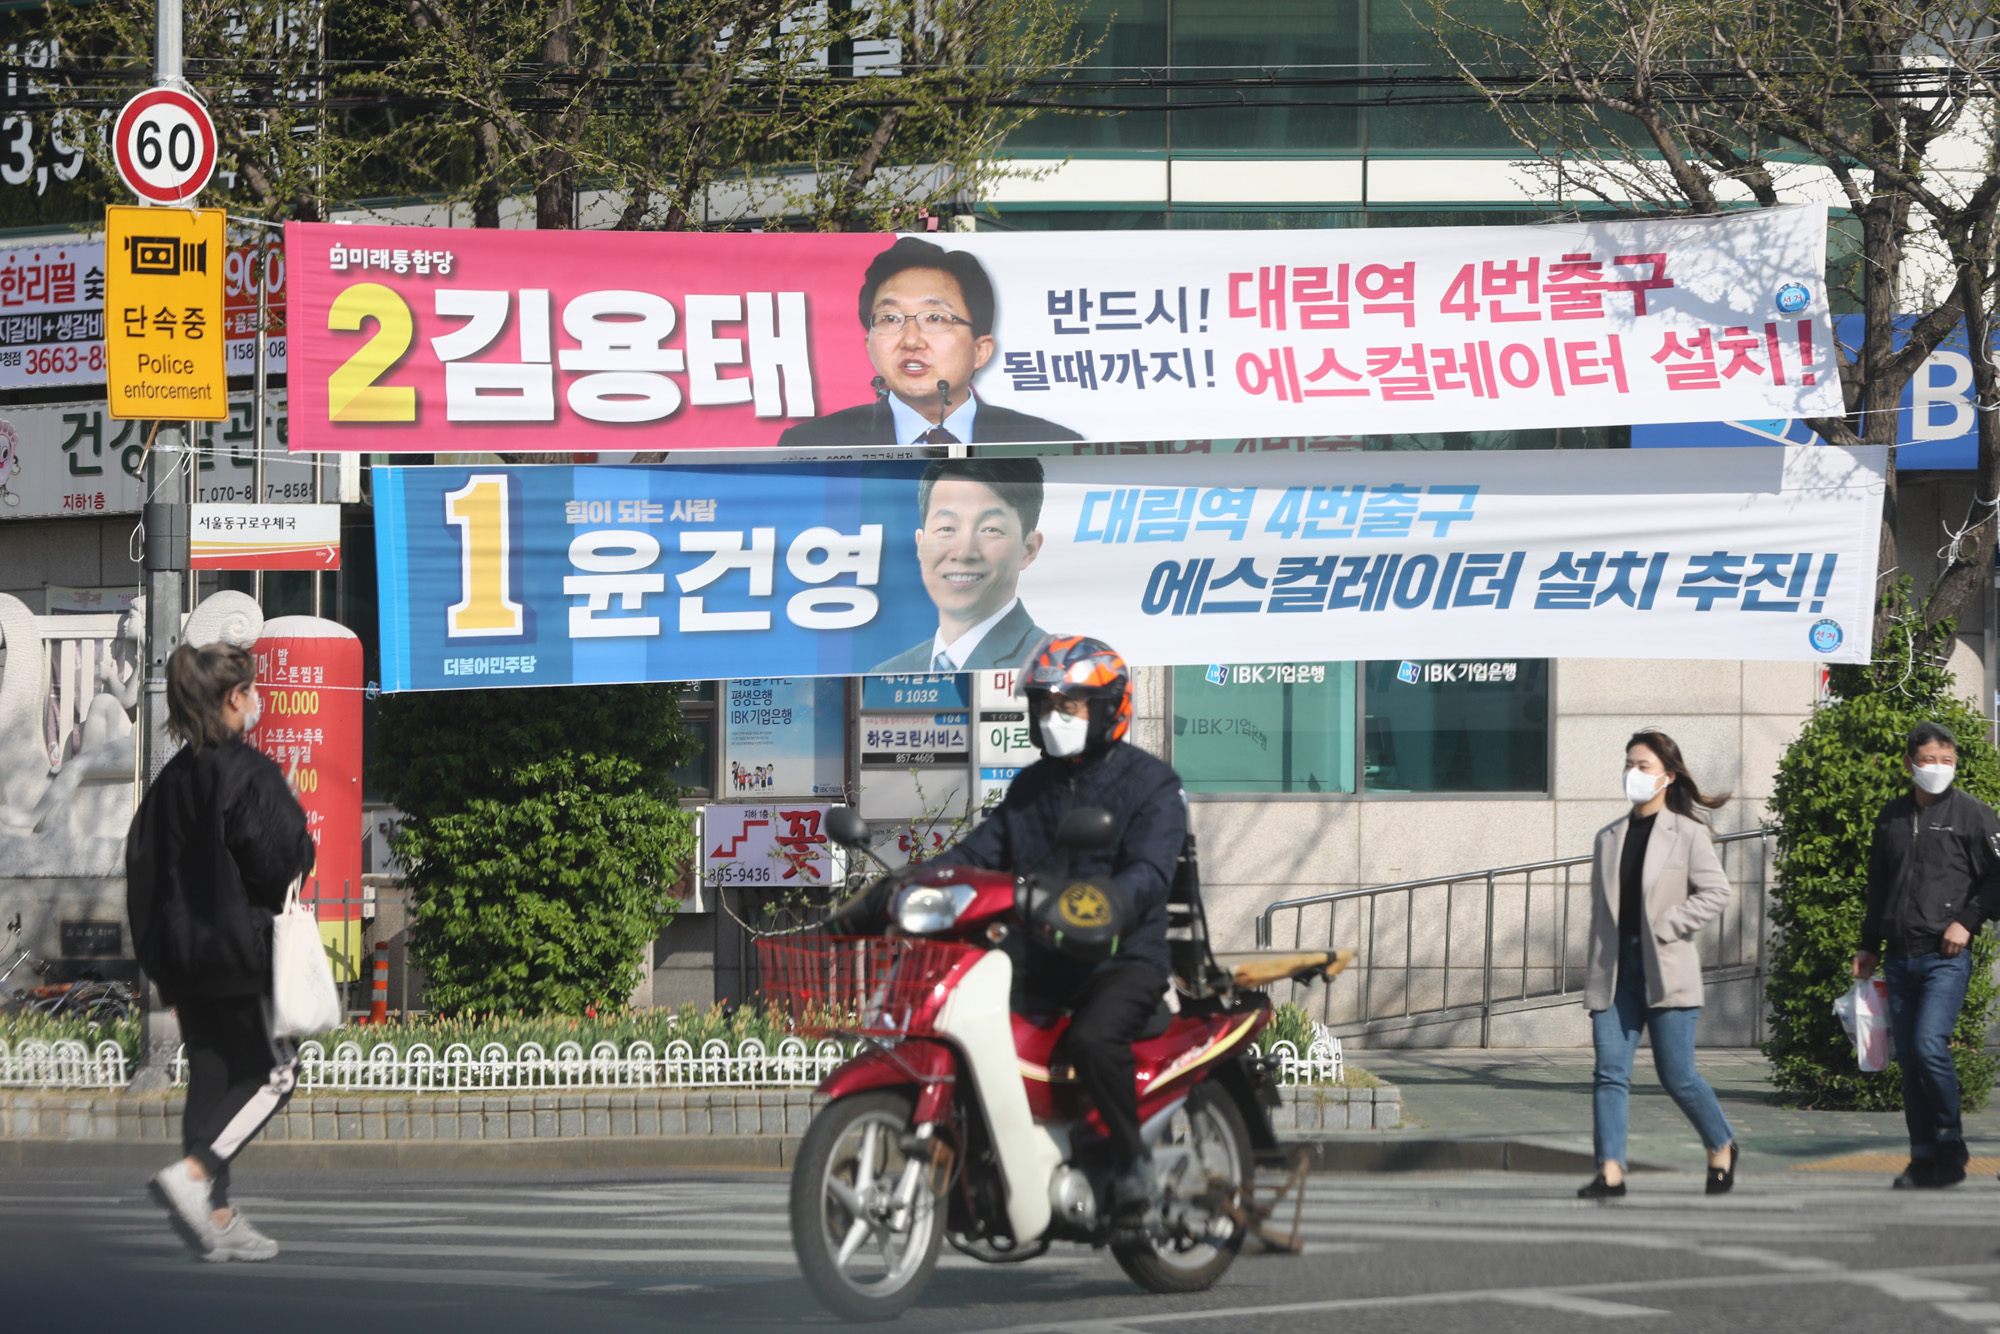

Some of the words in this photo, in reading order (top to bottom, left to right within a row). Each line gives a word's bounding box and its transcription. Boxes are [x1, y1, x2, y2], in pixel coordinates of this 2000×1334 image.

[136, 119, 196, 173] 60
[349, 247, 455, 275] 미래통합당
[1047, 286, 1211, 335] 반드시!
[1228, 261, 1417, 332] 대림역
[1439, 252, 1674, 323] 4번출구
[123, 304, 207, 340] 단속중
[25, 344, 107, 375] 3663-8
[328, 282, 416, 421] 2
[430, 288, 816, 423] 김용태
[1003, 347, 1216, 392] 될때까지!
[1235, 334, 1630, 404] 에스컬레이터
[1651, 318, 1816, 391] 설치!
[137, 353, 195, 375] Police
[123, 381, 212, 401] enforcement
[63, 492, 106, 511] 지하1층
[565, 500, 612, 524] 힘이
[617, 499, 664, 523] 되는
[669, 499, 718, 523] 사람
[199, 516, 296, 531] 서울동구로우체국
[1074, 486, 1258, 545] 대림역
[1264, 483, 1480, 540] 4번출구
[445, 474, 524, 639] 1
[563, 524, 884, 639] 윤건영
[1141, 552, 1527, 616] 에스컬레이터
[1533, 551, 1669, 611] 설치
[1676, 550, 1838, 614] 추진!
[277, 648, 289, 666] 발
[443, 656, 538, 677] 더불어민주당
[276, 666, 324, 683] 스톤찜질
[1232, 665, 1326, 684] IBK기업은행
[1424, 662, 1518, 682] IBK기업은행
[269, 691, 320, 718] 70,000
[731, 689, 773, 707] 평생은행
[895, 690, 903, 703] B
[906, 689, 939, 703] 103호
[731, 708, 793, 725] IBK기업은행
[942, 714, 961, 723] 104
[265, 728, 324, 745] 스포츠+족욕
[867, 729, 965, 749] 하우크린서비스
[991, 768, 1015, 779] 110
[744, 810, 757, 819] 지하
[774, 810, 828, 880] 꽃
